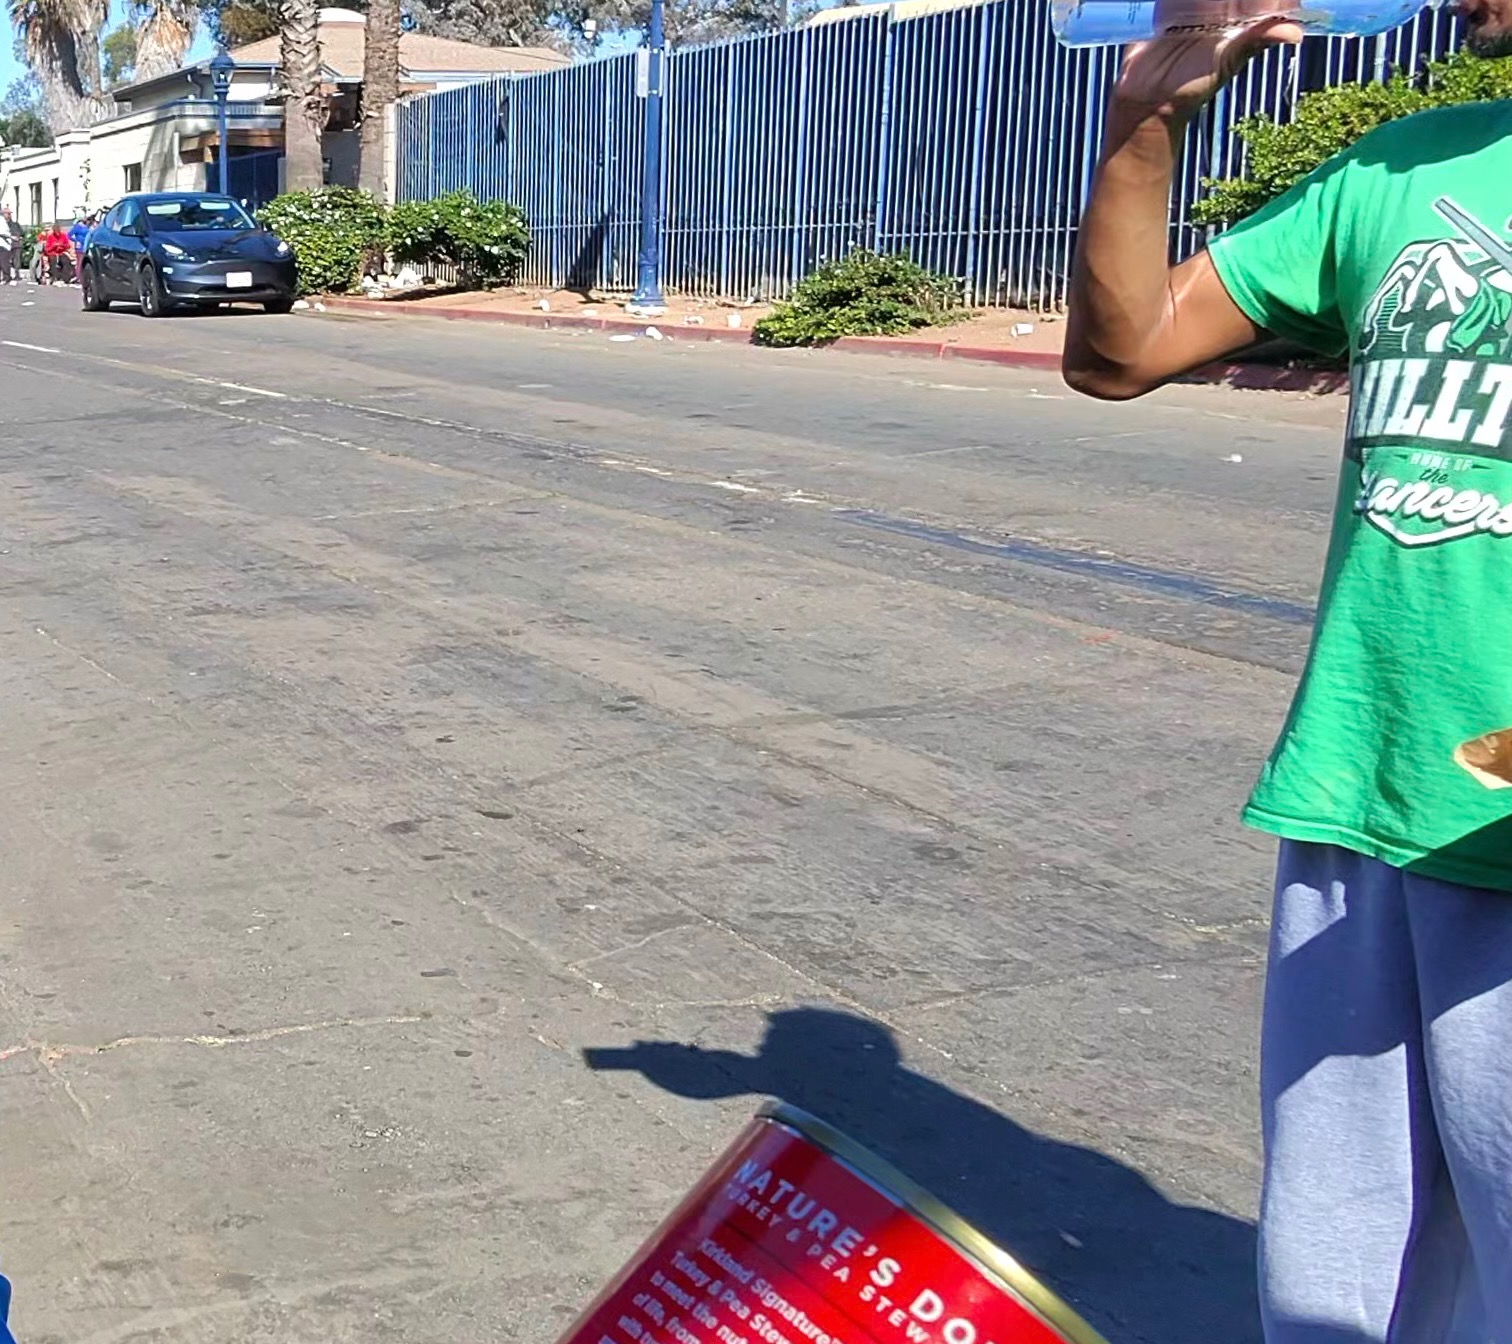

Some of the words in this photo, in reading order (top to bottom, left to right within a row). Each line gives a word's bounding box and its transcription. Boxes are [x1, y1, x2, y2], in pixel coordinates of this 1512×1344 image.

[1419, 468, 1449, 485] the
[734, 1159, 901, 1287] NATURE'S
[719, 1288, 751, 1320] Pea
[807, 1243, 849, 1282] PEA
[858, 1284, 930, 1343] STEW
[691, 1302, 718, 1329] the
